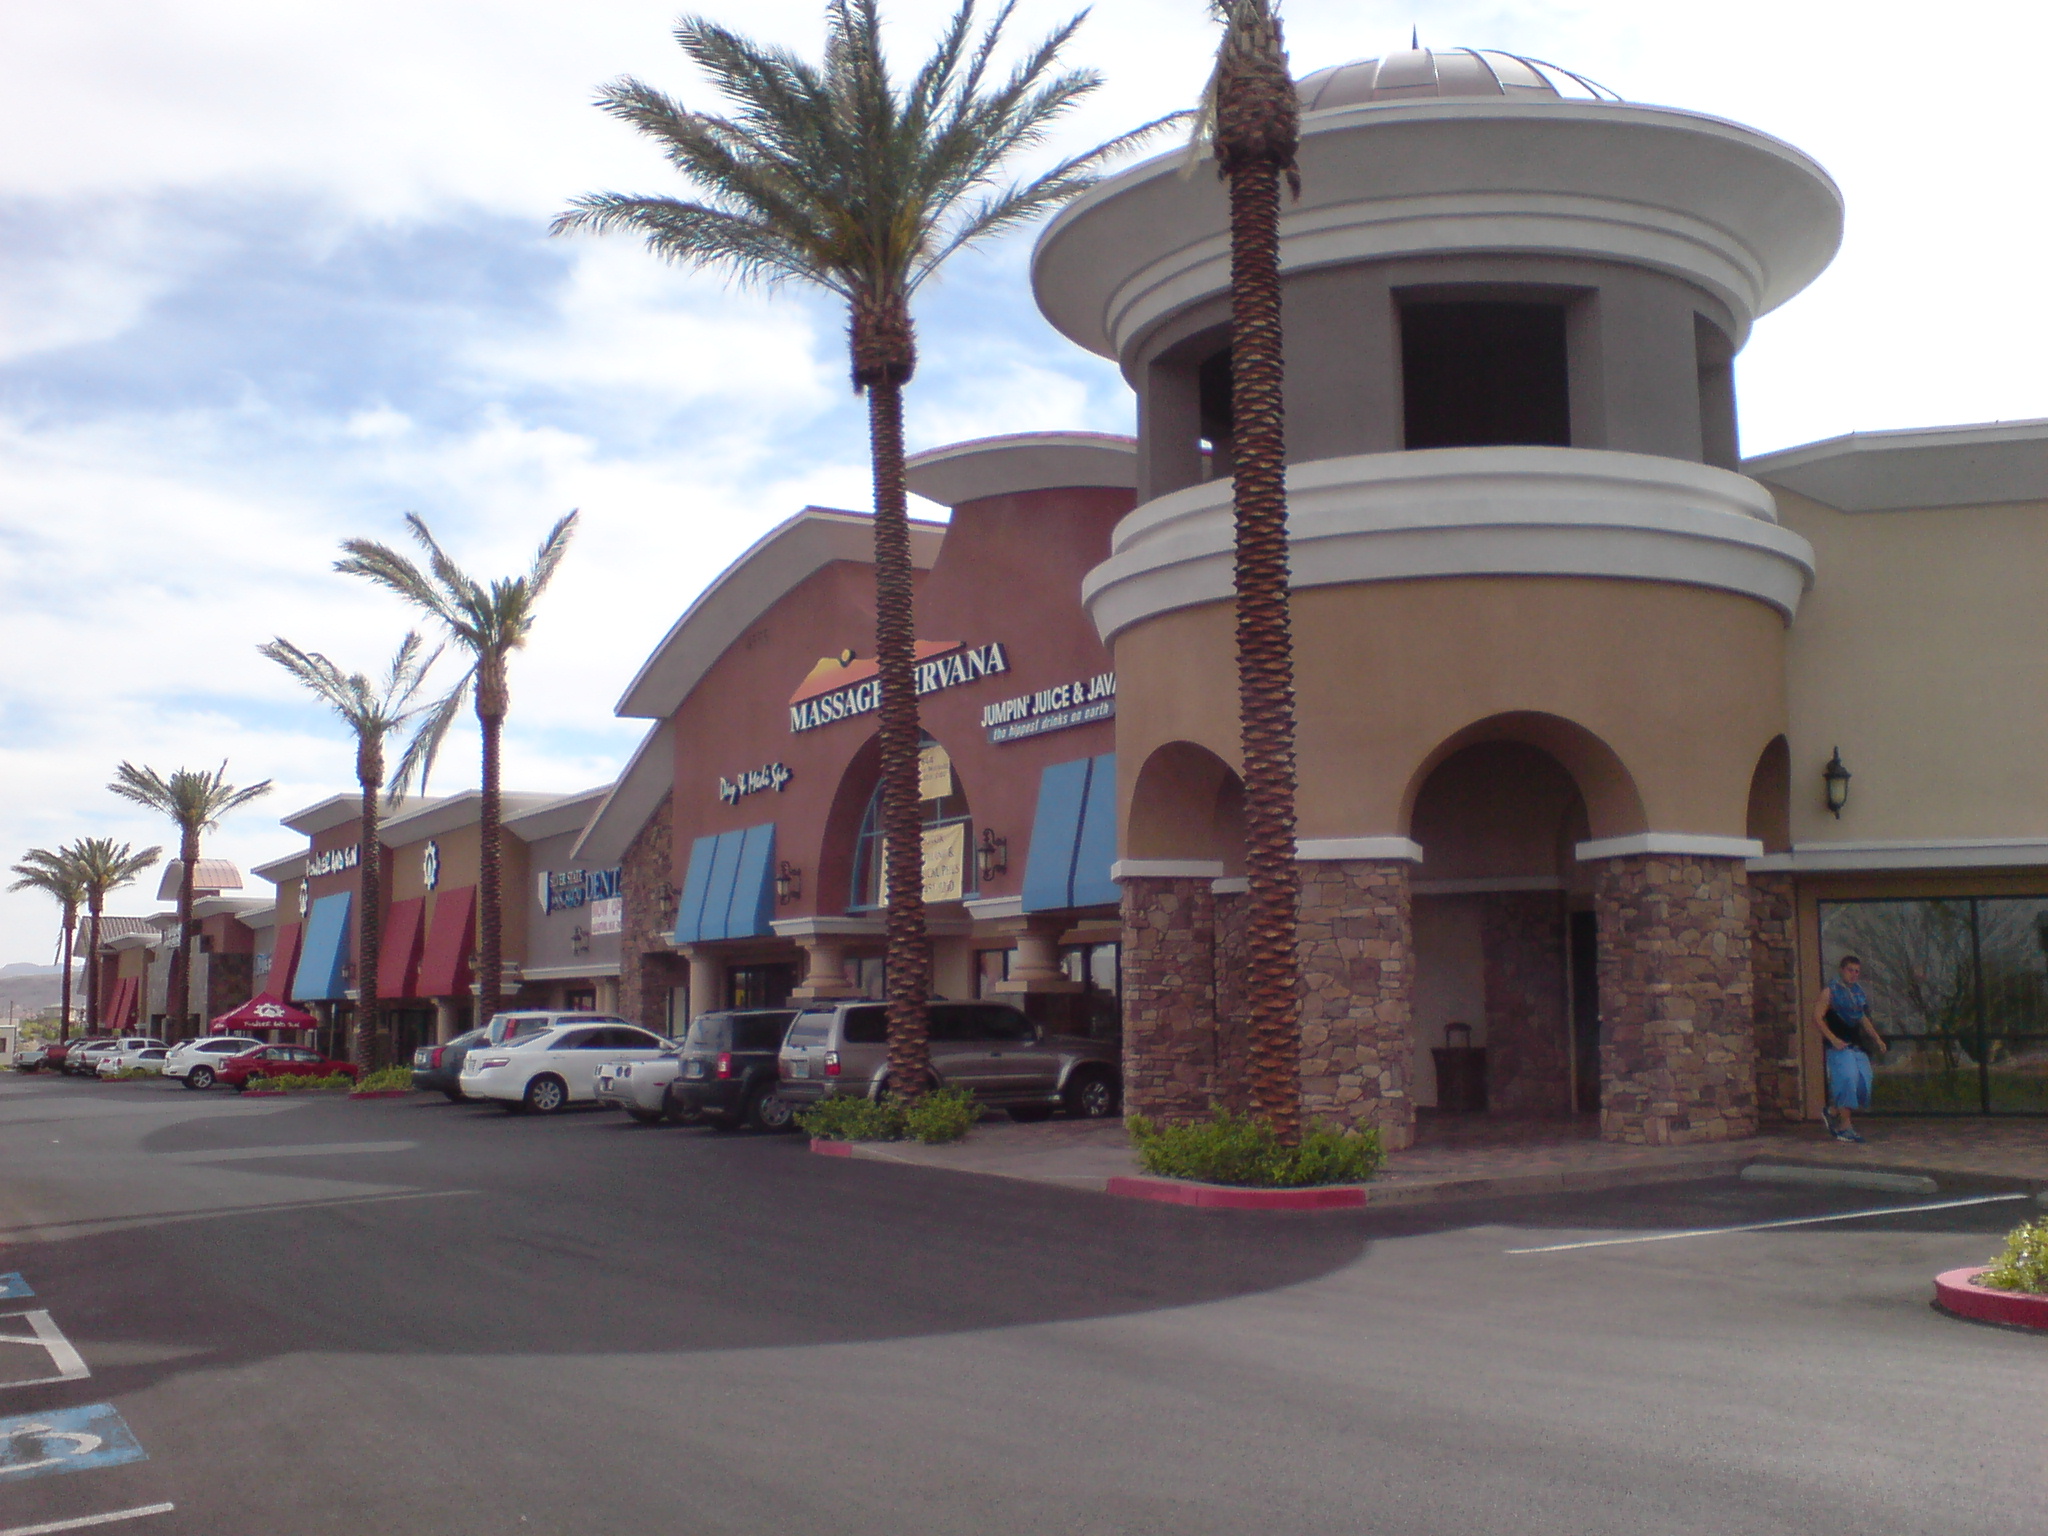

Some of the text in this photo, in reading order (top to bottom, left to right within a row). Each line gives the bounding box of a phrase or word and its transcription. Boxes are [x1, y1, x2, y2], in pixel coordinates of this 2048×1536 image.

[914, 642, 1006, 695] IRVANA
[981, 694, 1030, 727] JUMPIN'
[1032, 684, 1071, 715] JUICE
[1073, 681, 1084, 704] &
[993, 702, 1110, 740] the biggest drinks on earth
